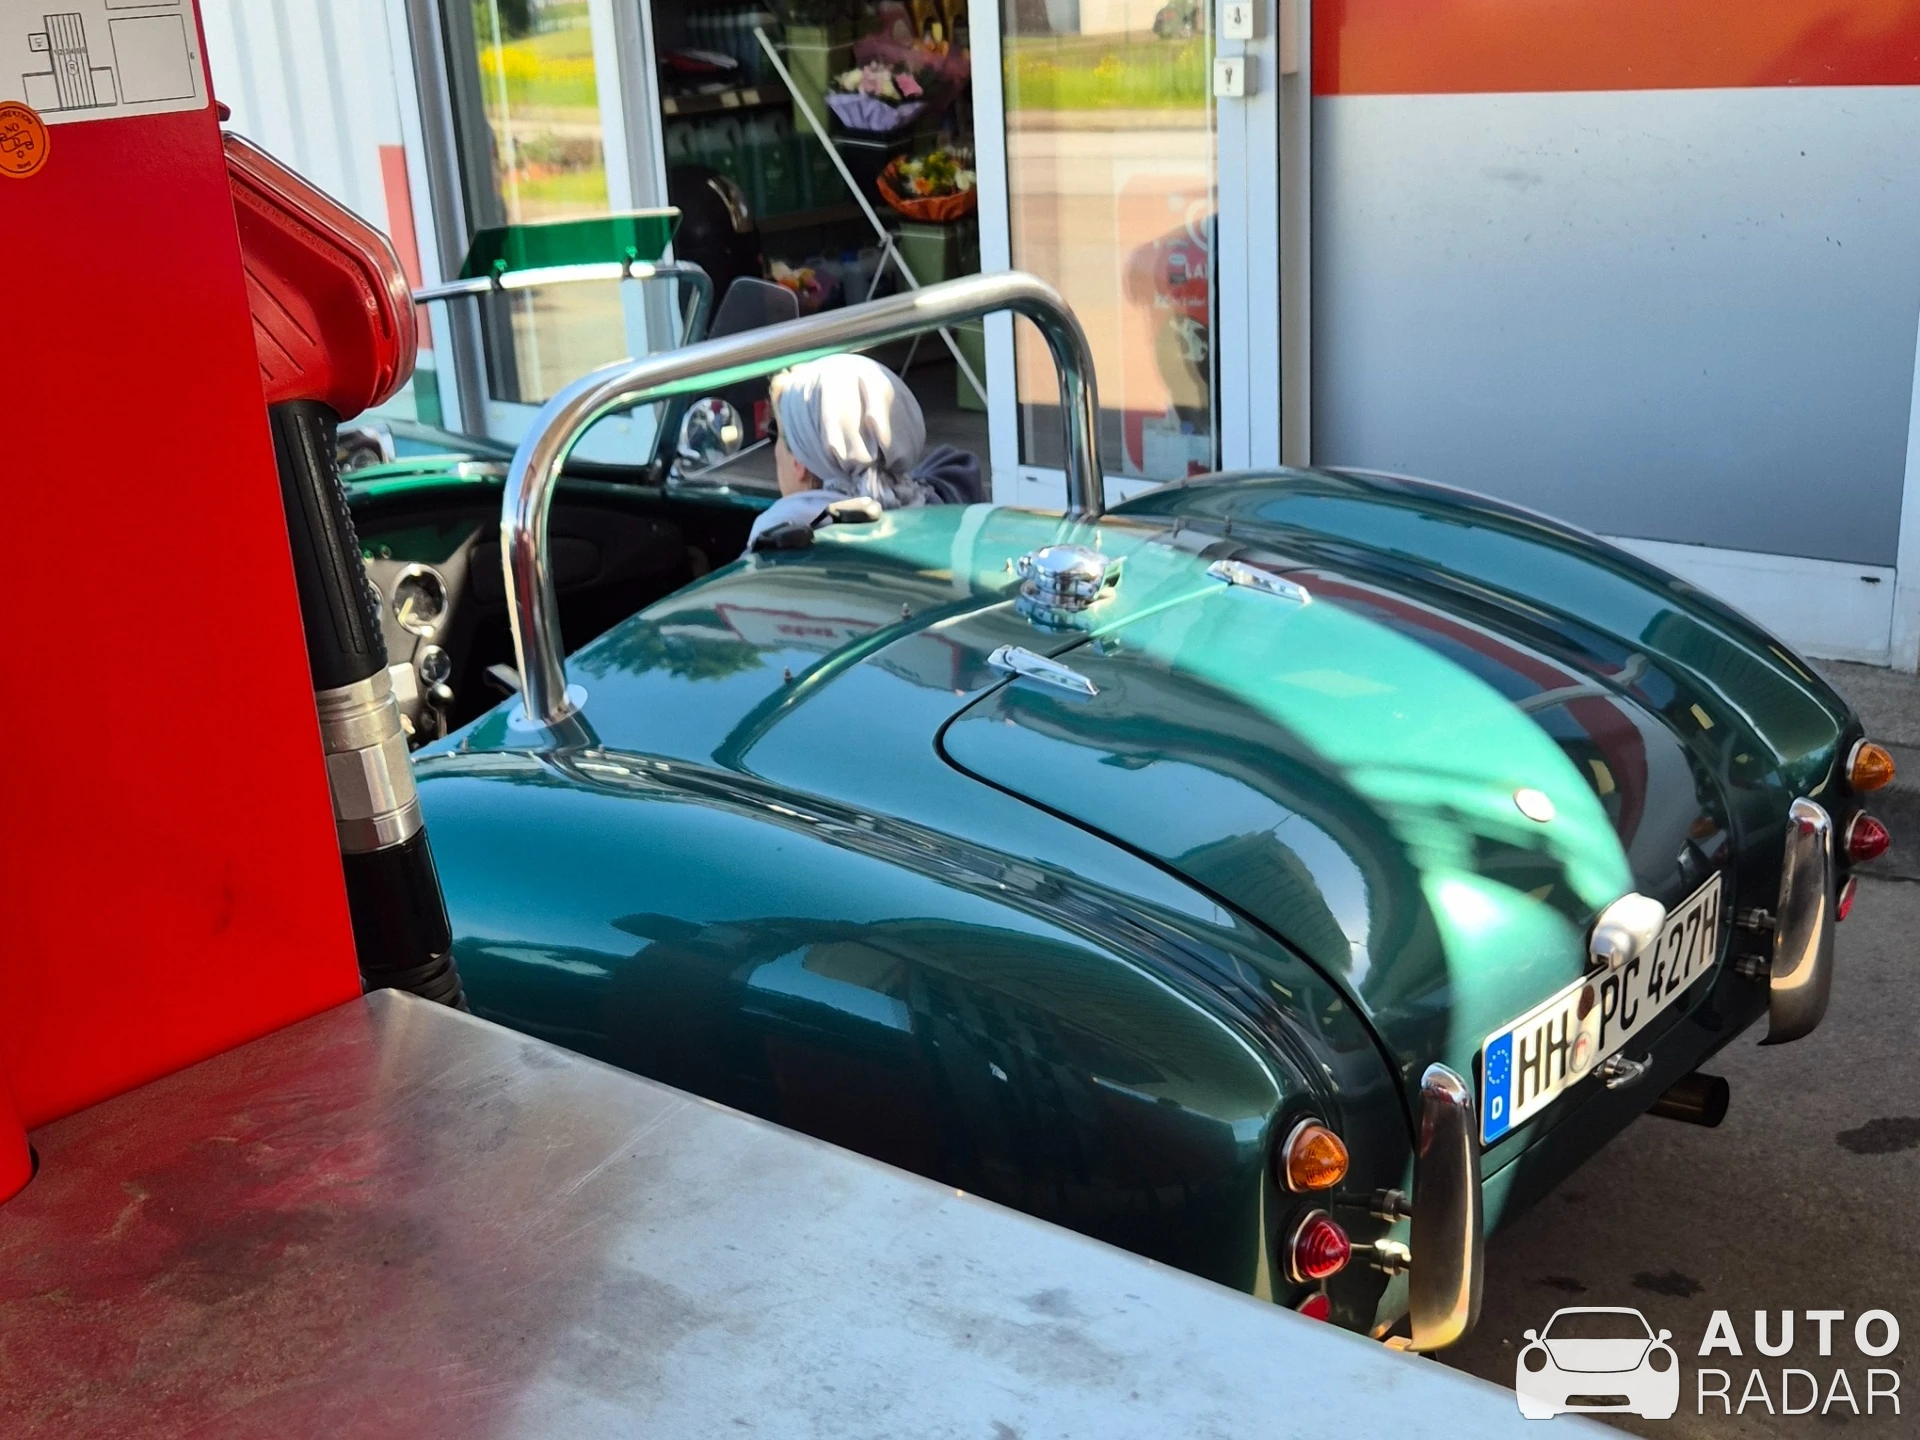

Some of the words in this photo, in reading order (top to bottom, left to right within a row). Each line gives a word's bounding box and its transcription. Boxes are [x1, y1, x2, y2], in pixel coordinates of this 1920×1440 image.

[1516, 1009, 1569, 1110] HH
[1598, 956, 1640, 1052] PC
[1647, 888, 1719, 1004] 427H
[1491, 1095, 1503, 1120] D
